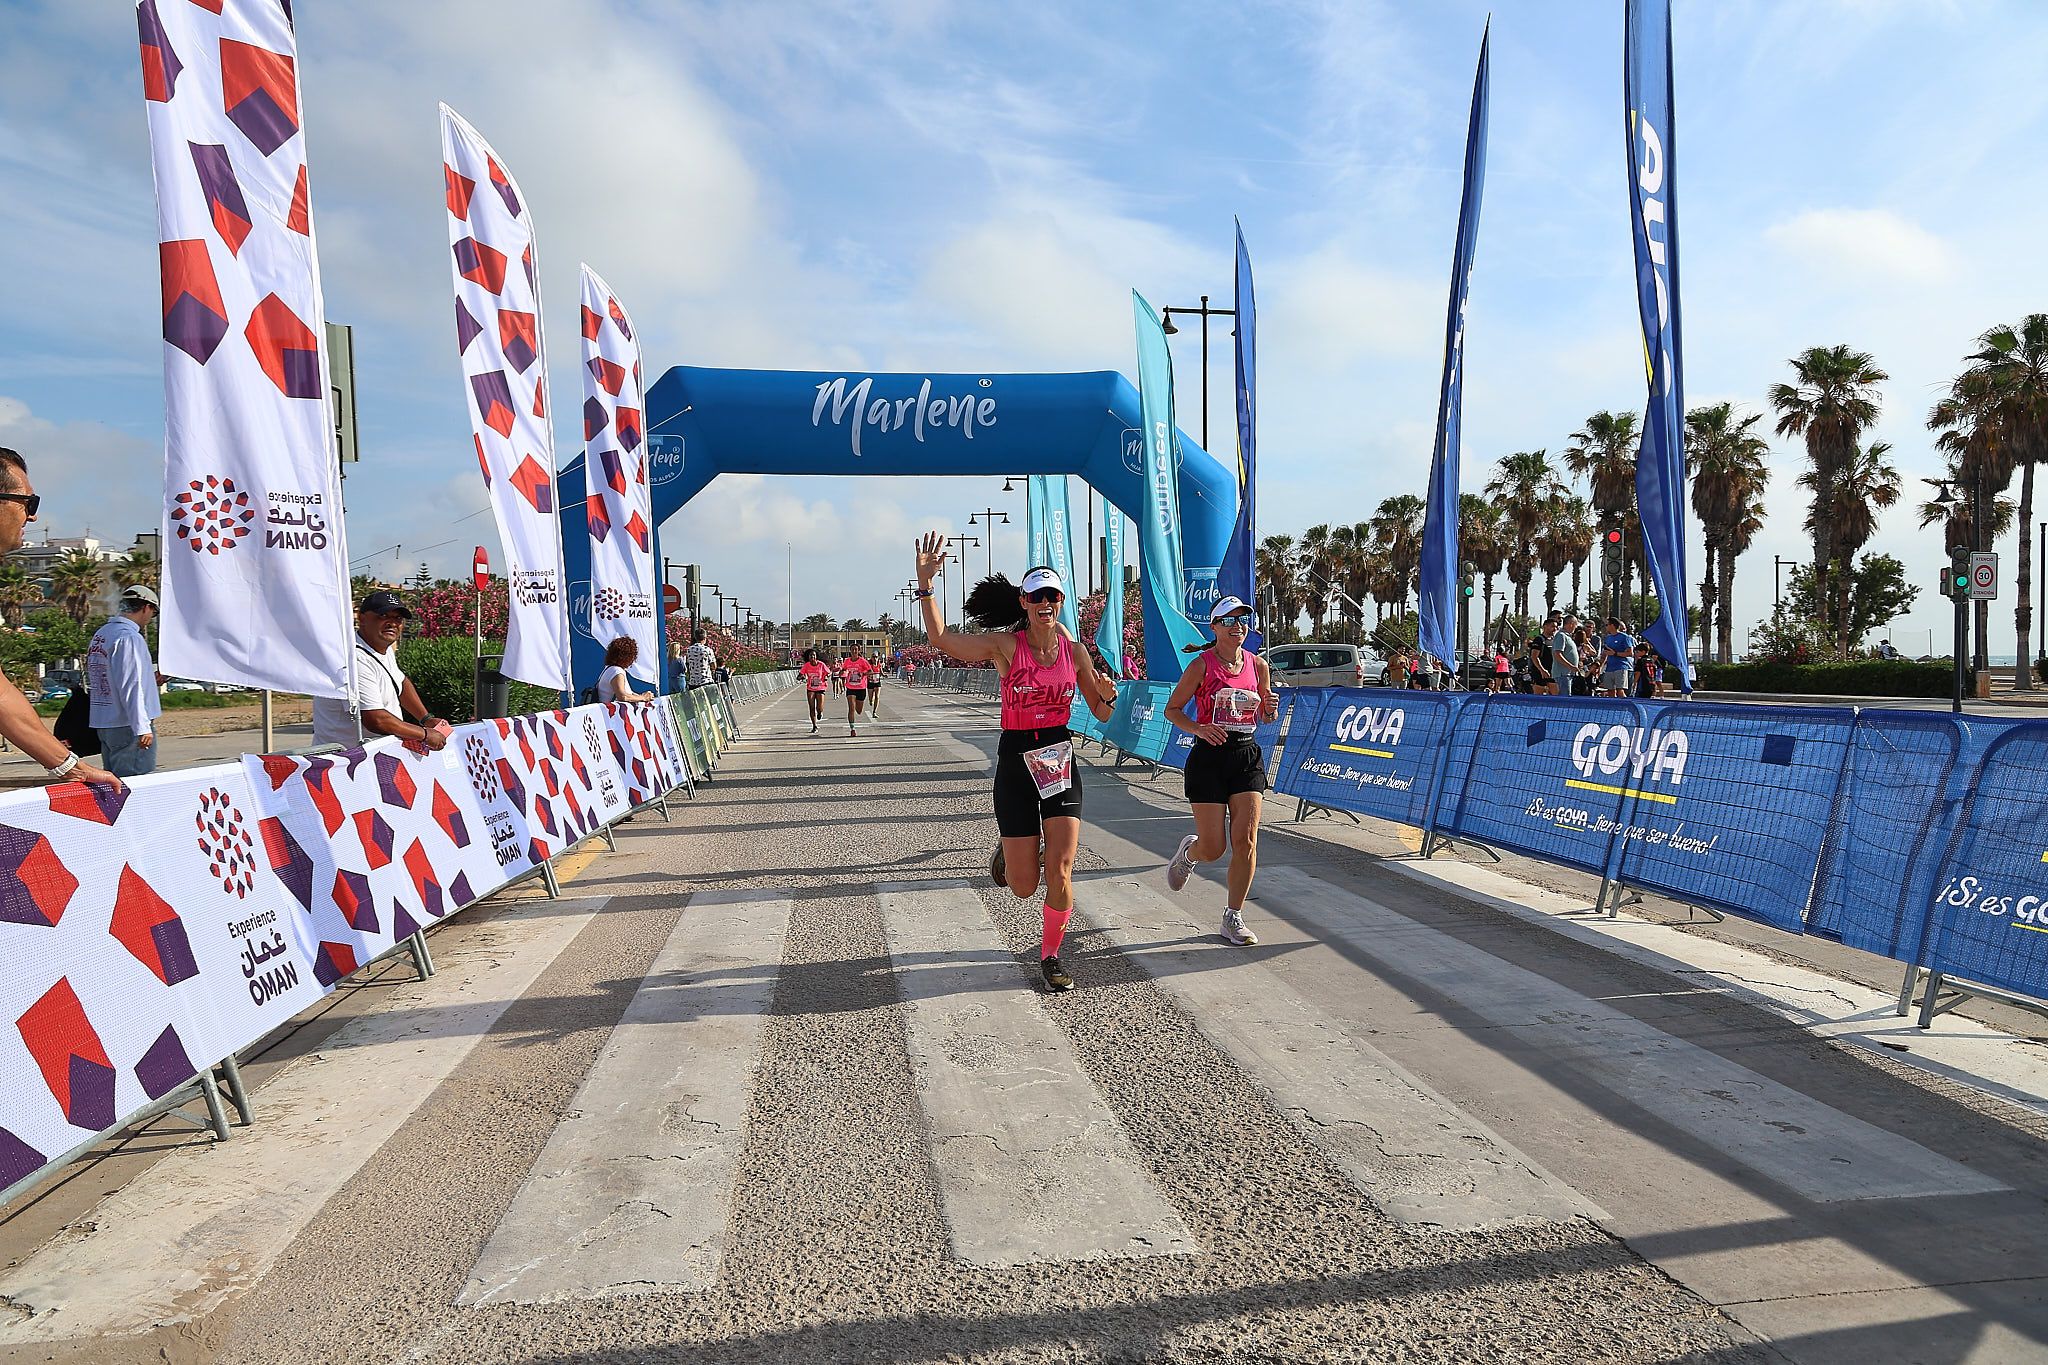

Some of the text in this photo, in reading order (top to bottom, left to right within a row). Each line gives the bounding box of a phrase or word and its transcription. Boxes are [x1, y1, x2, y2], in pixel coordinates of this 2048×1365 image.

[812, 377, 997, 456] Marlene
[648, 446, 680, 467] rlene
[1978, 572, 1990, 580] 30
[1336, 705, 1405, 745] GOYA
[1572, 723, 1689, 785] GOYA
[1320, 762, 1341, 776] GOYA
[1358, 773, 1374, 790] que
[1373, 775, 1387, 785] ser
[1386, 769, 1414, 791] bueno!
[1543, 807, 1557, 821] es
[1556, 806, 1588, 827] GOYA
[1622, 822, 1647, 849] que
[1645, 828, 1668, 844] ser
[1667, 822, 1718, 855] bueno!
[496, 842, 522, 867] OMAN
[1935, 876, 1983, 909] ¡Si
[1979, 896, 2013, 916] es
[228, 909, 277, 939] Experience
[249, 960, 299, 1007] OMAN
